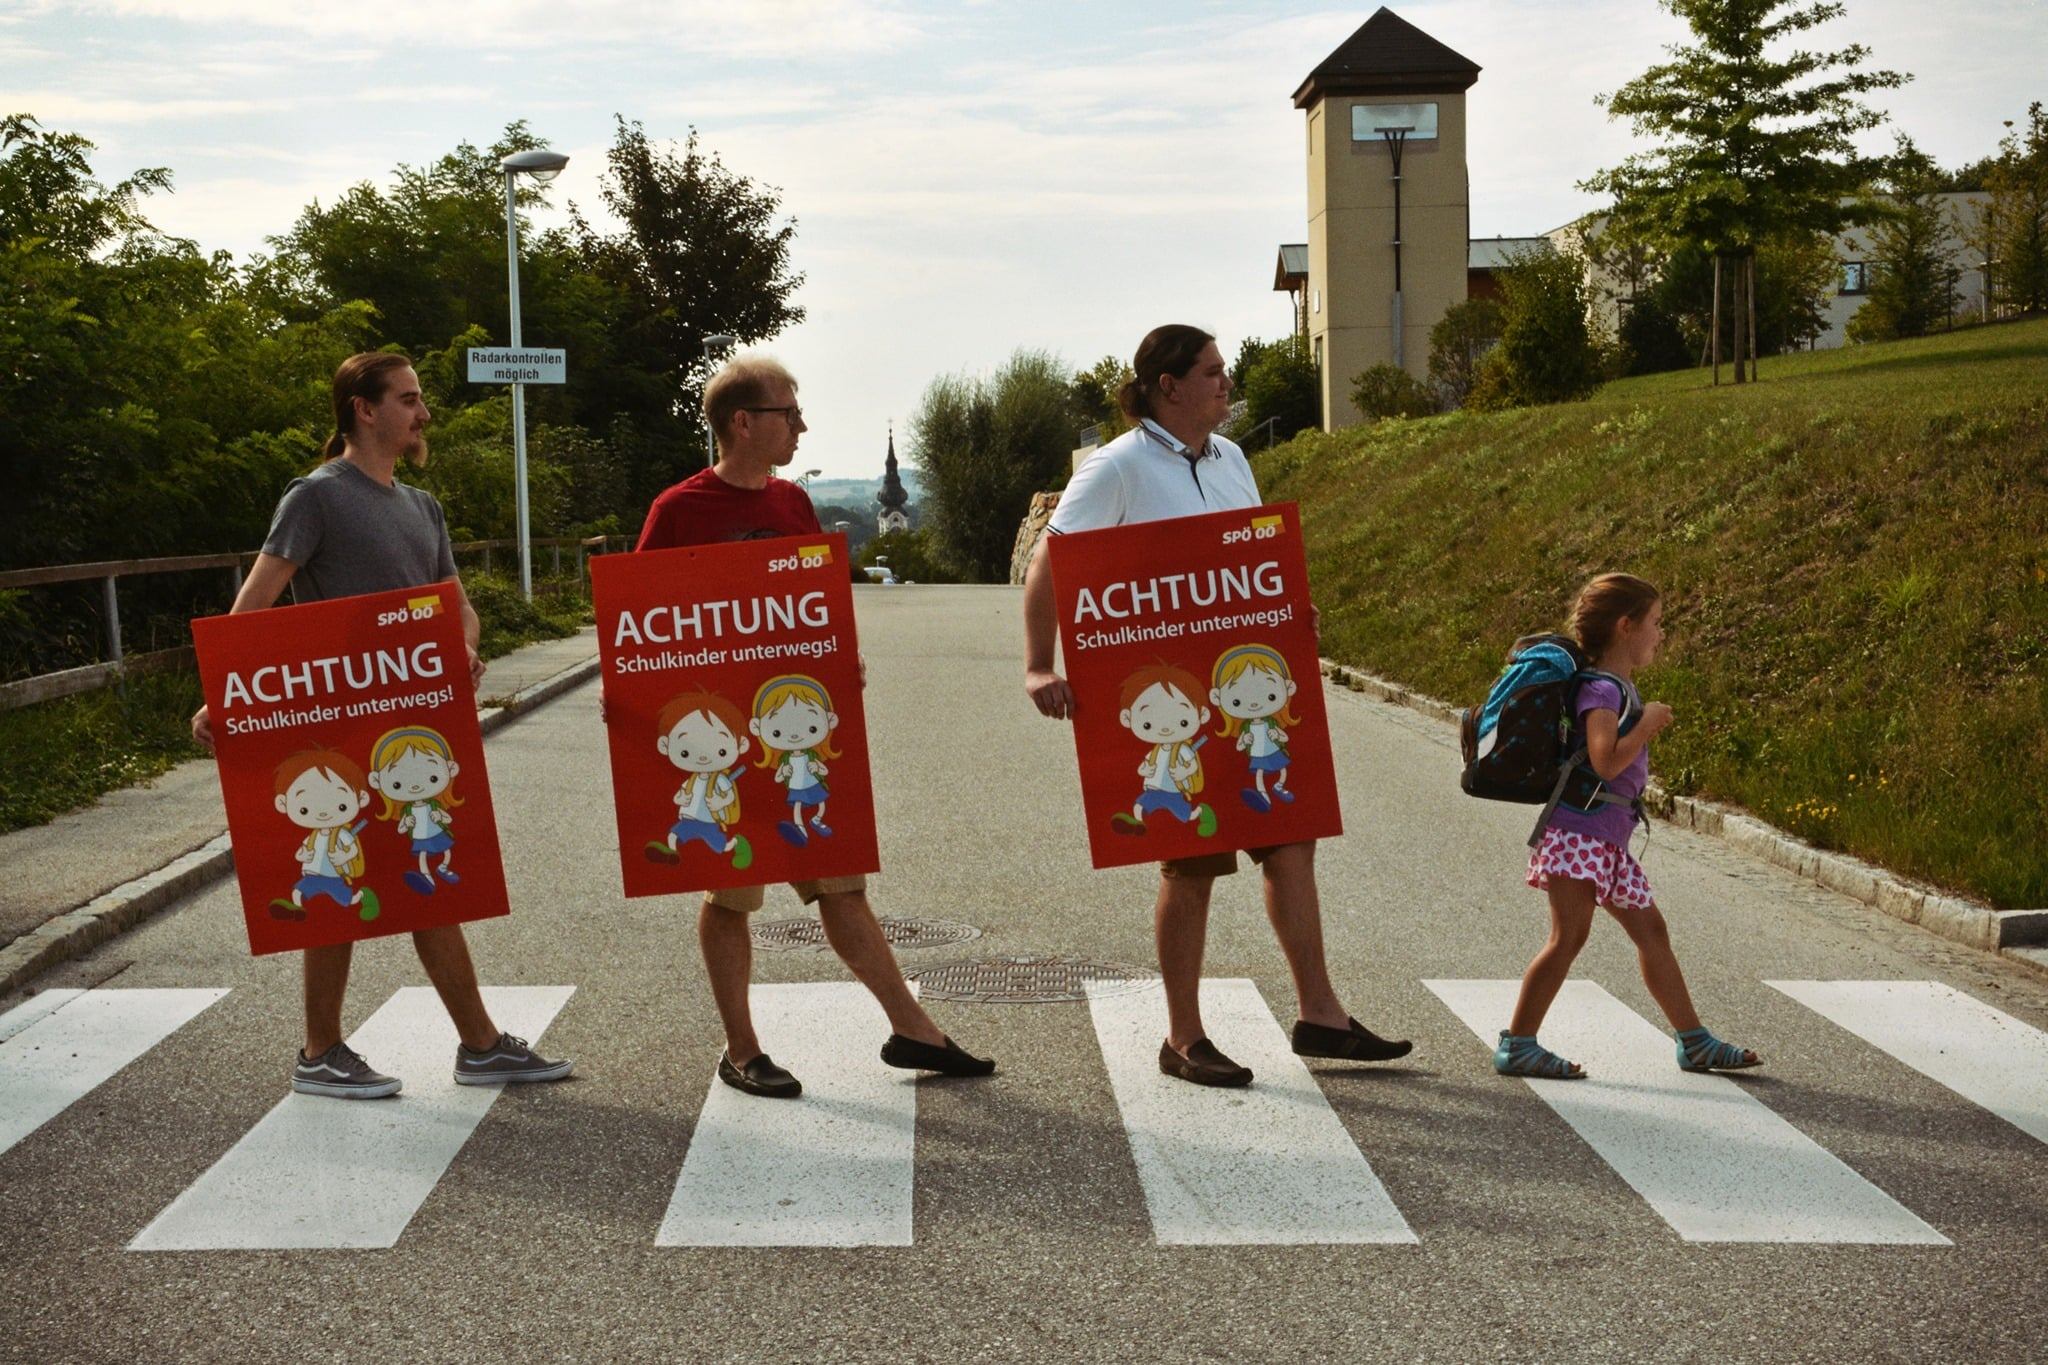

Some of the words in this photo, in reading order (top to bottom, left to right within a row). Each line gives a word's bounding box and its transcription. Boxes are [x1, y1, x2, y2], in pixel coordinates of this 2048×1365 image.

[472, 352, 562, 364] Radarkontrollen
[494, 368, 540, 381] möglich
[1222, 526, 1252, 544] SPÖ
[1255, 523, 1276, 540] OÖ
[768, 555, 798, 573] SPÖ
[801, 553, 823, 569] OÖ
[1074, 561, 1284, 624] ACHTUNG
[377, 607, 408, 626] SPÖ
[412, 604, 434, 620] OÖ
[614, 591, 829, 647] ACHTUNG
[1075, 620, 1186, 650] Schulkinder
[1190, 603, 1293, 634] unterwegs!
[615, 647, 728, 674] Schulkinder
[731, 635, 838, 662] unterwegs!
[223, 641, 444, 709] ACHTUNG
[225, 704, 341, 735] Schulkinder
[346, 684, 454, 718] unterwegs!
